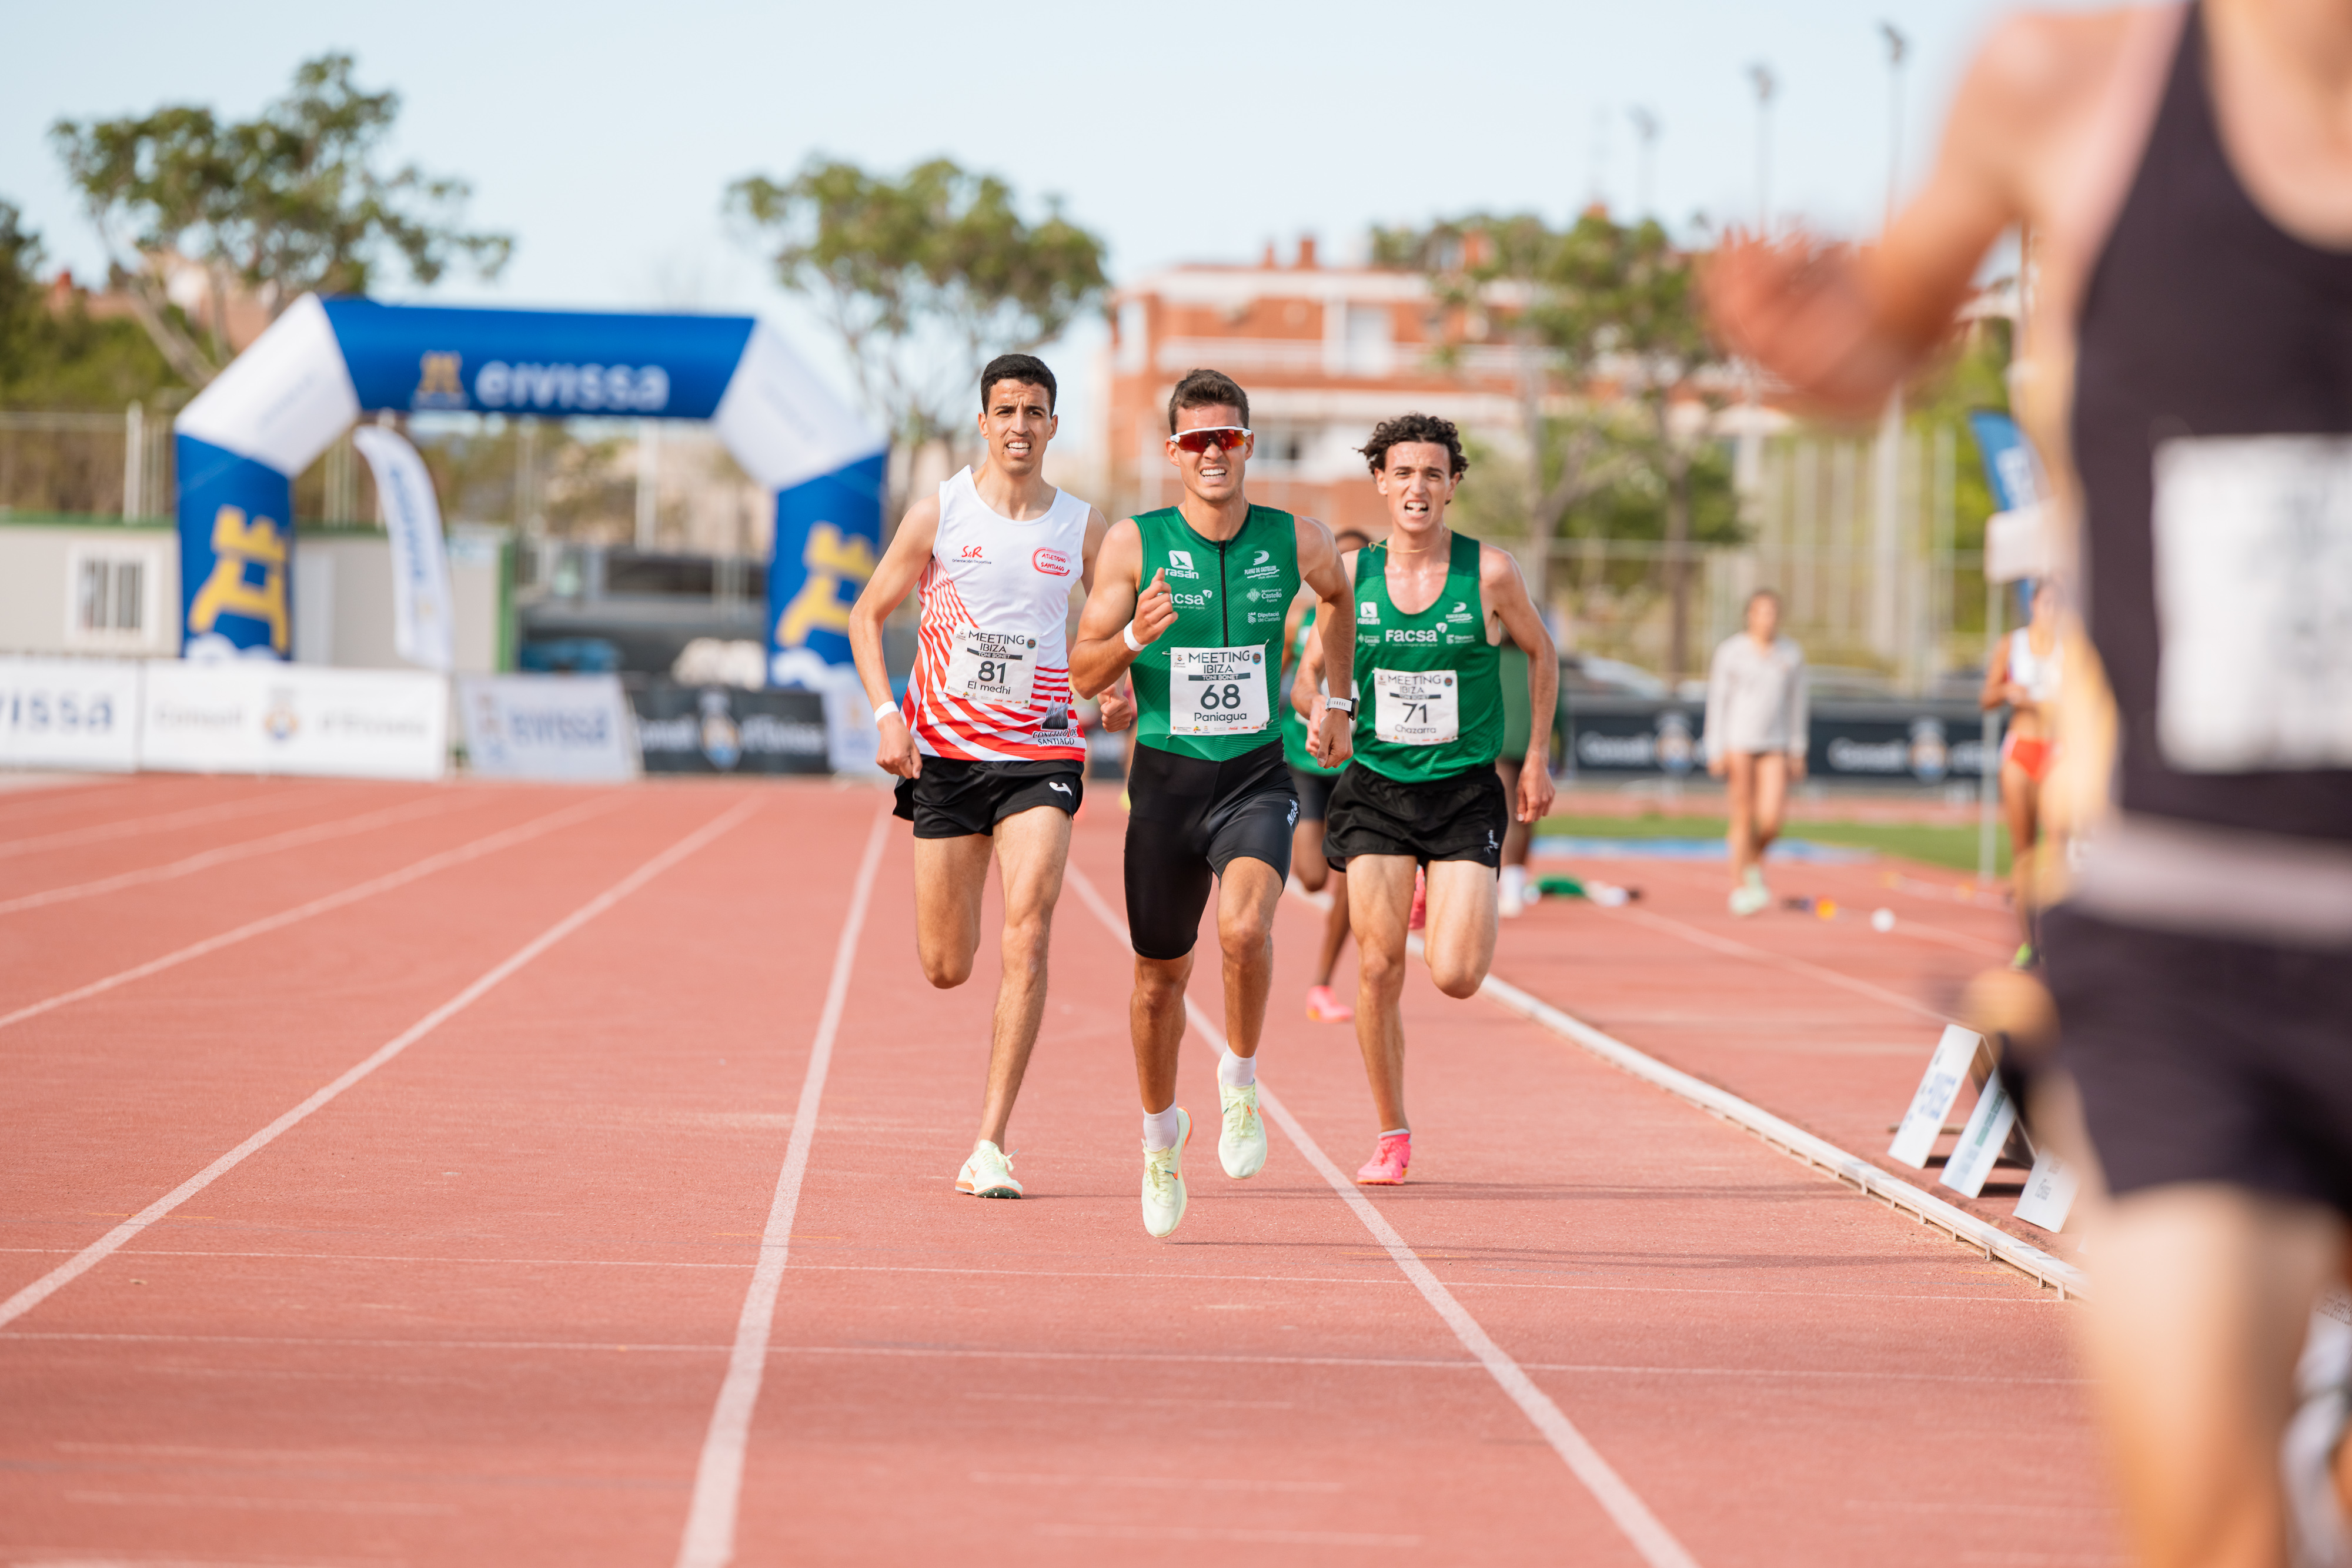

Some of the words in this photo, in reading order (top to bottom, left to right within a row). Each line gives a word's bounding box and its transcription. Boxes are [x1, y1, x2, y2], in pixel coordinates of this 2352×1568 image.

[961, 546, 983, 558] S&R
[1041, 553, 1065, 563] ATLETISMO
[1041, 562, 1064, 571] SANTIAGO
[1165, 568, 1199, 580] rasán
[968, 630, 1024, 645] MEETING
[980, 643, 1006, 653] IBIZA
[1188, 650, 1250, 663] MEETING
[978, 661, 1006, 684] 81
[1204, 664, 1234, 674] IBIZA
[1388, 675, 1441, 685] MEETING
[967, 681, 977, 689] El
[980, 684, 1011, 694] medhi
[1200, 684, 1241, 710] 68
[1194, 712, 1247, 723] Paniagua
[1402, 703, 1426, 723] 71
[1395, 724, 1436, 734] Chazarra
[1037, 737, 1074, 745] SANTIAGO
